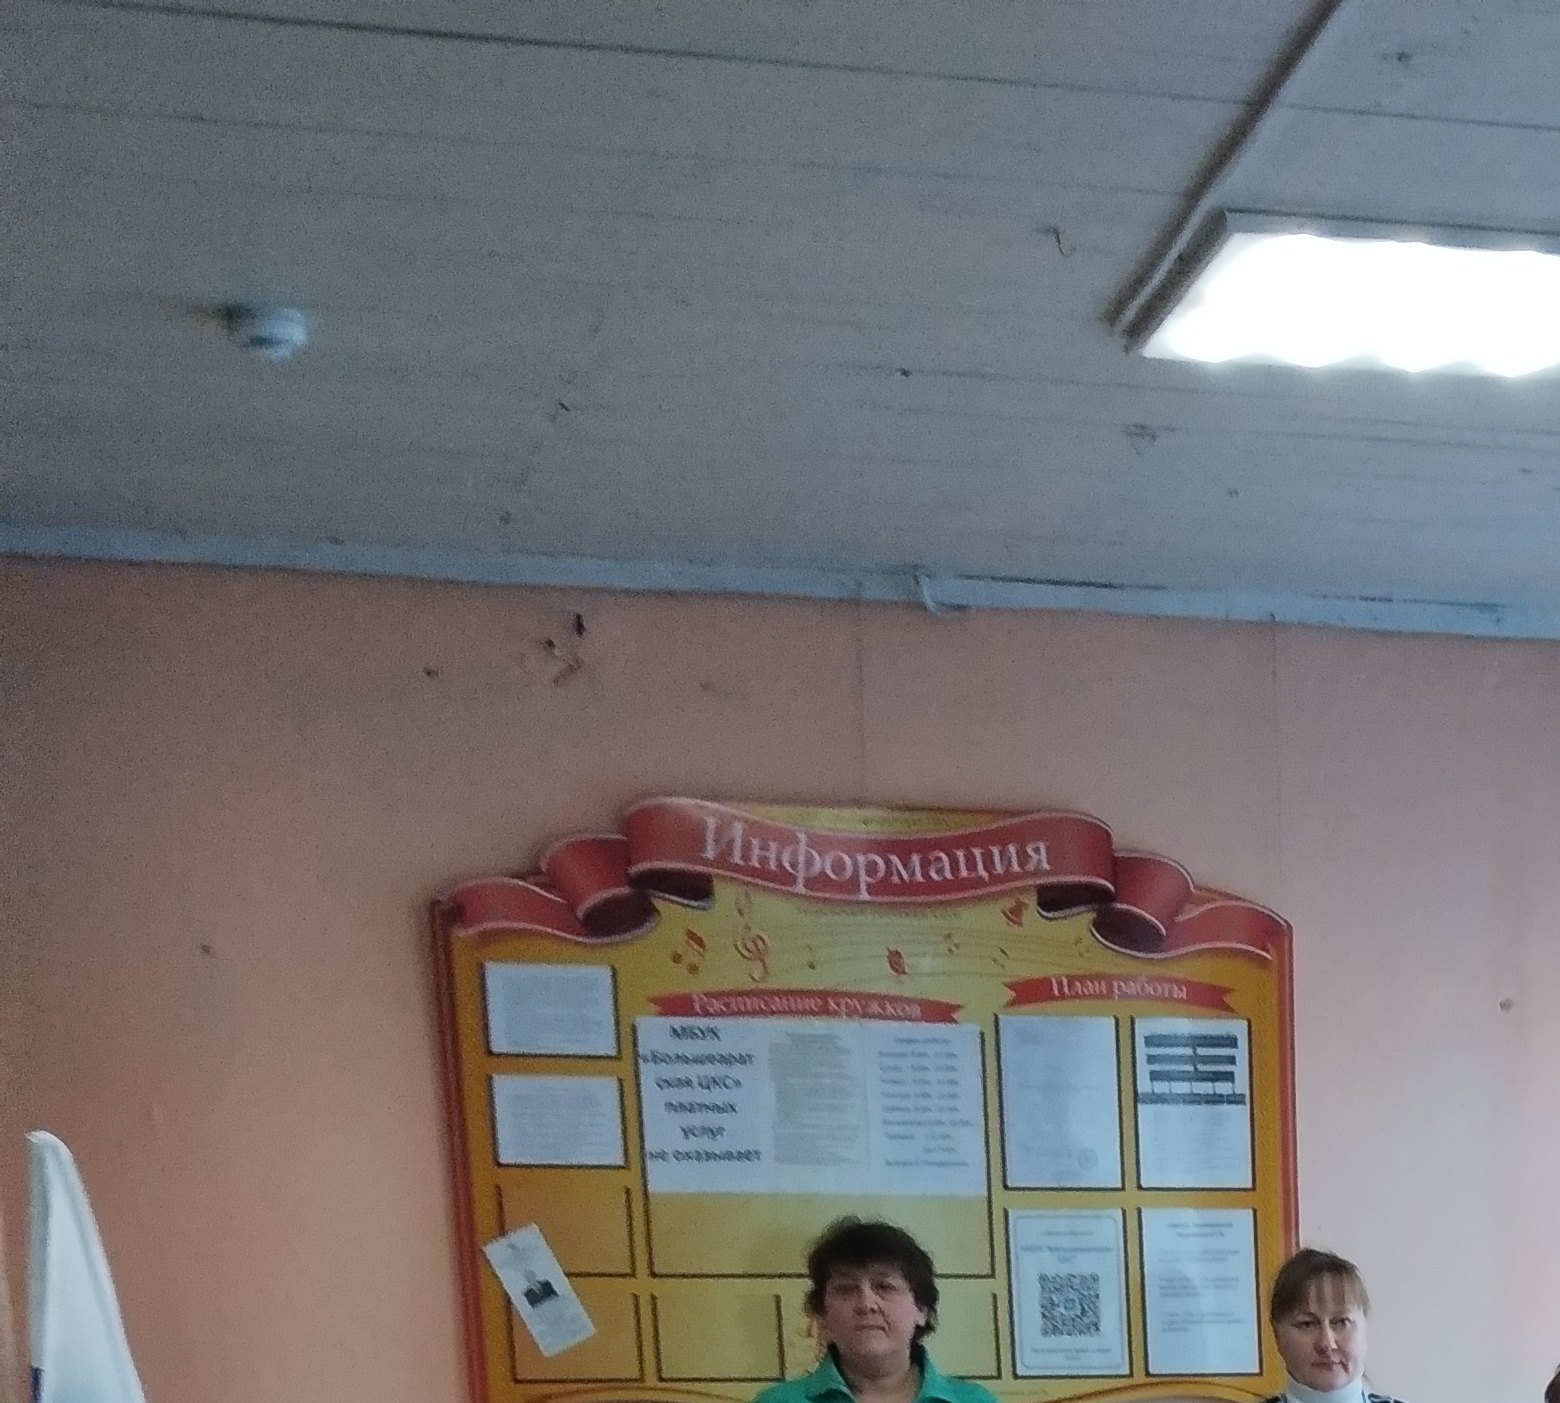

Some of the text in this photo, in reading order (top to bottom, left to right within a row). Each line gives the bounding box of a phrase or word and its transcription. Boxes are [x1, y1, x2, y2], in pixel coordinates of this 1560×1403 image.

[702, 816, 1051, 900] Информация
[1050, 977, 1188, 1000] План работы
[692, 993, 922, 1020] Расписание кружков
